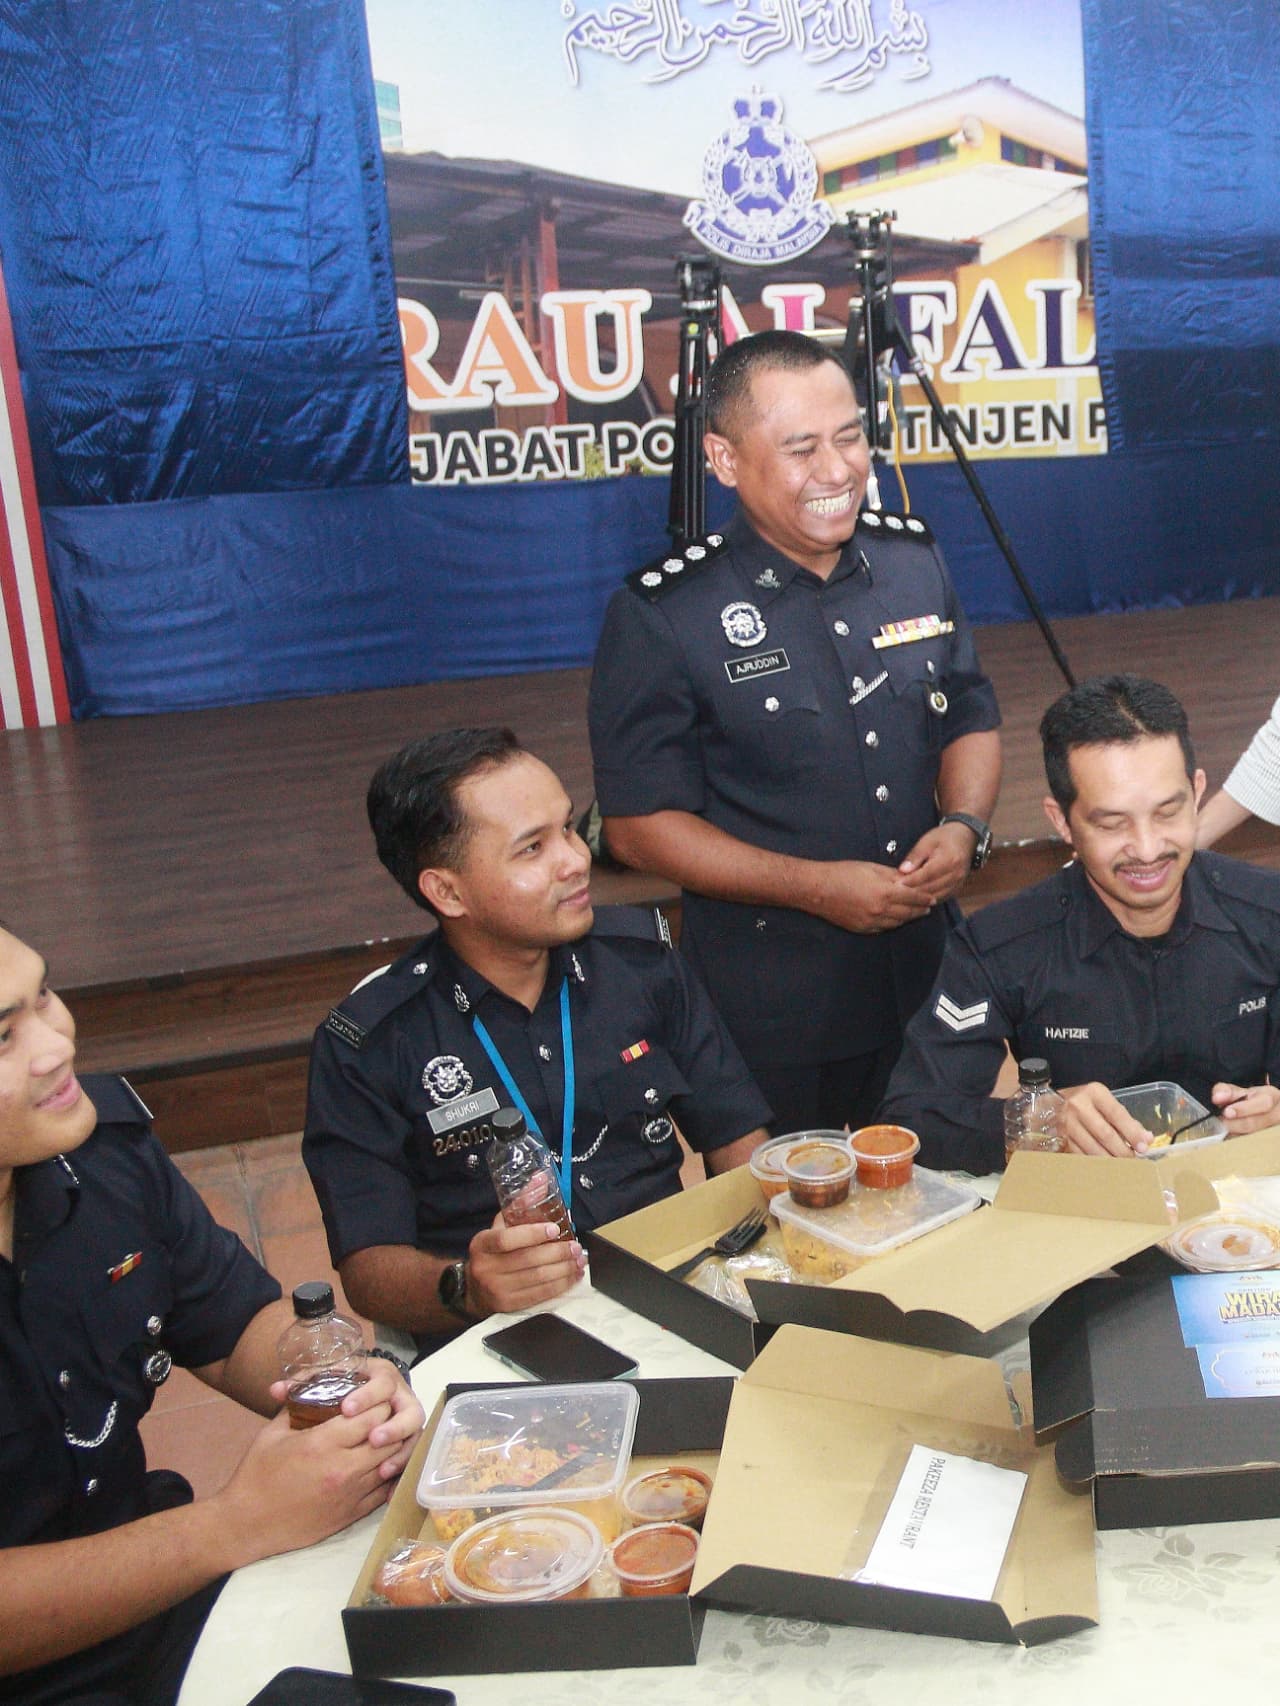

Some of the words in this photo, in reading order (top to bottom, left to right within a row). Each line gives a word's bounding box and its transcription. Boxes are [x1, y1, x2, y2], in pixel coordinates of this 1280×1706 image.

[700, 223, 731, 250] POLIS
[732, 244, 772, 259] DIRAJA
[774, 222, 823, 257] MALAYSIA
[409, 423, 595, 484] JABAT
[603, 418, 679, 474] PO
[886, 399, 1079, 456] TINJEN
[736, 655, 780, 675] AJRUDDIN
[1239, 996, 1267, 1015] POLIS
[1045, 1027, 1090, 1040] HAFIZIE
[445, 1100, 480, 1122] SHUKRI
[919, 1457, 946, 1495] PAKEEZA
